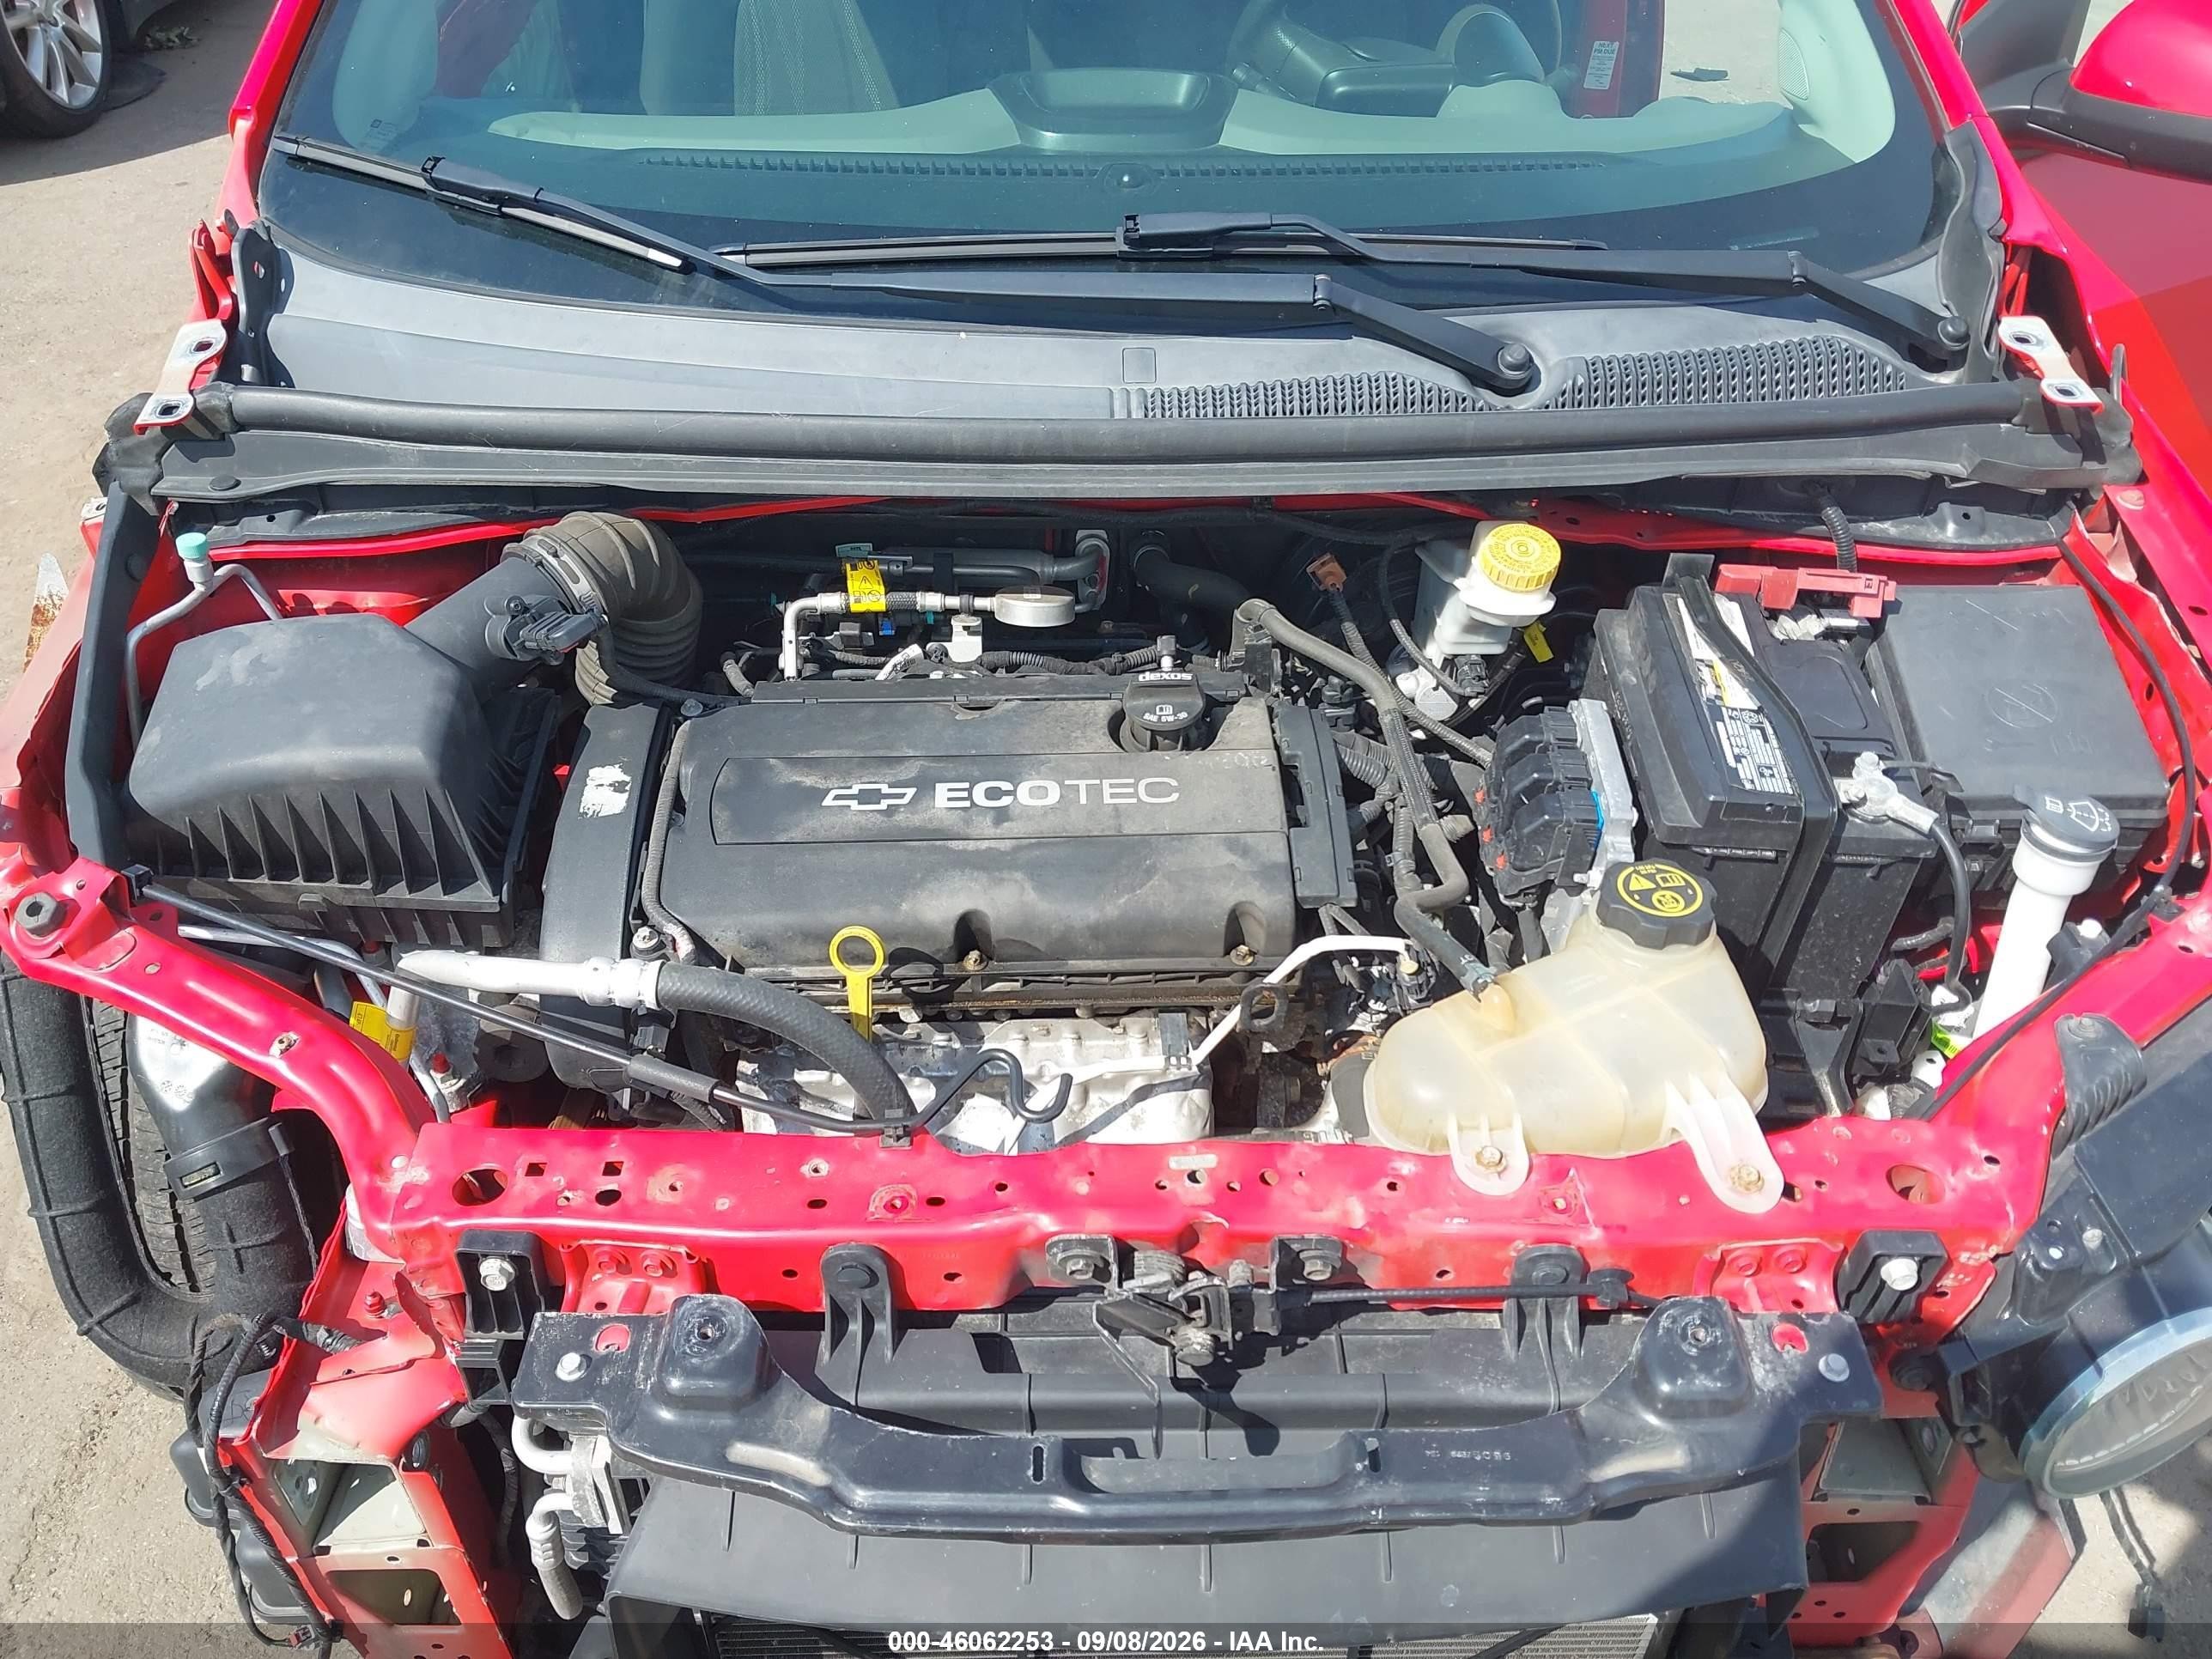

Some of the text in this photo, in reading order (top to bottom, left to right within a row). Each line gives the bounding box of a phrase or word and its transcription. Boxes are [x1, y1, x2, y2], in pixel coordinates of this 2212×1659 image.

[1138, 671, 1193, 682] dexos
[1142, 712, 1159, 722] SAE
[934, 776, 1180, 808] ECOTEC
